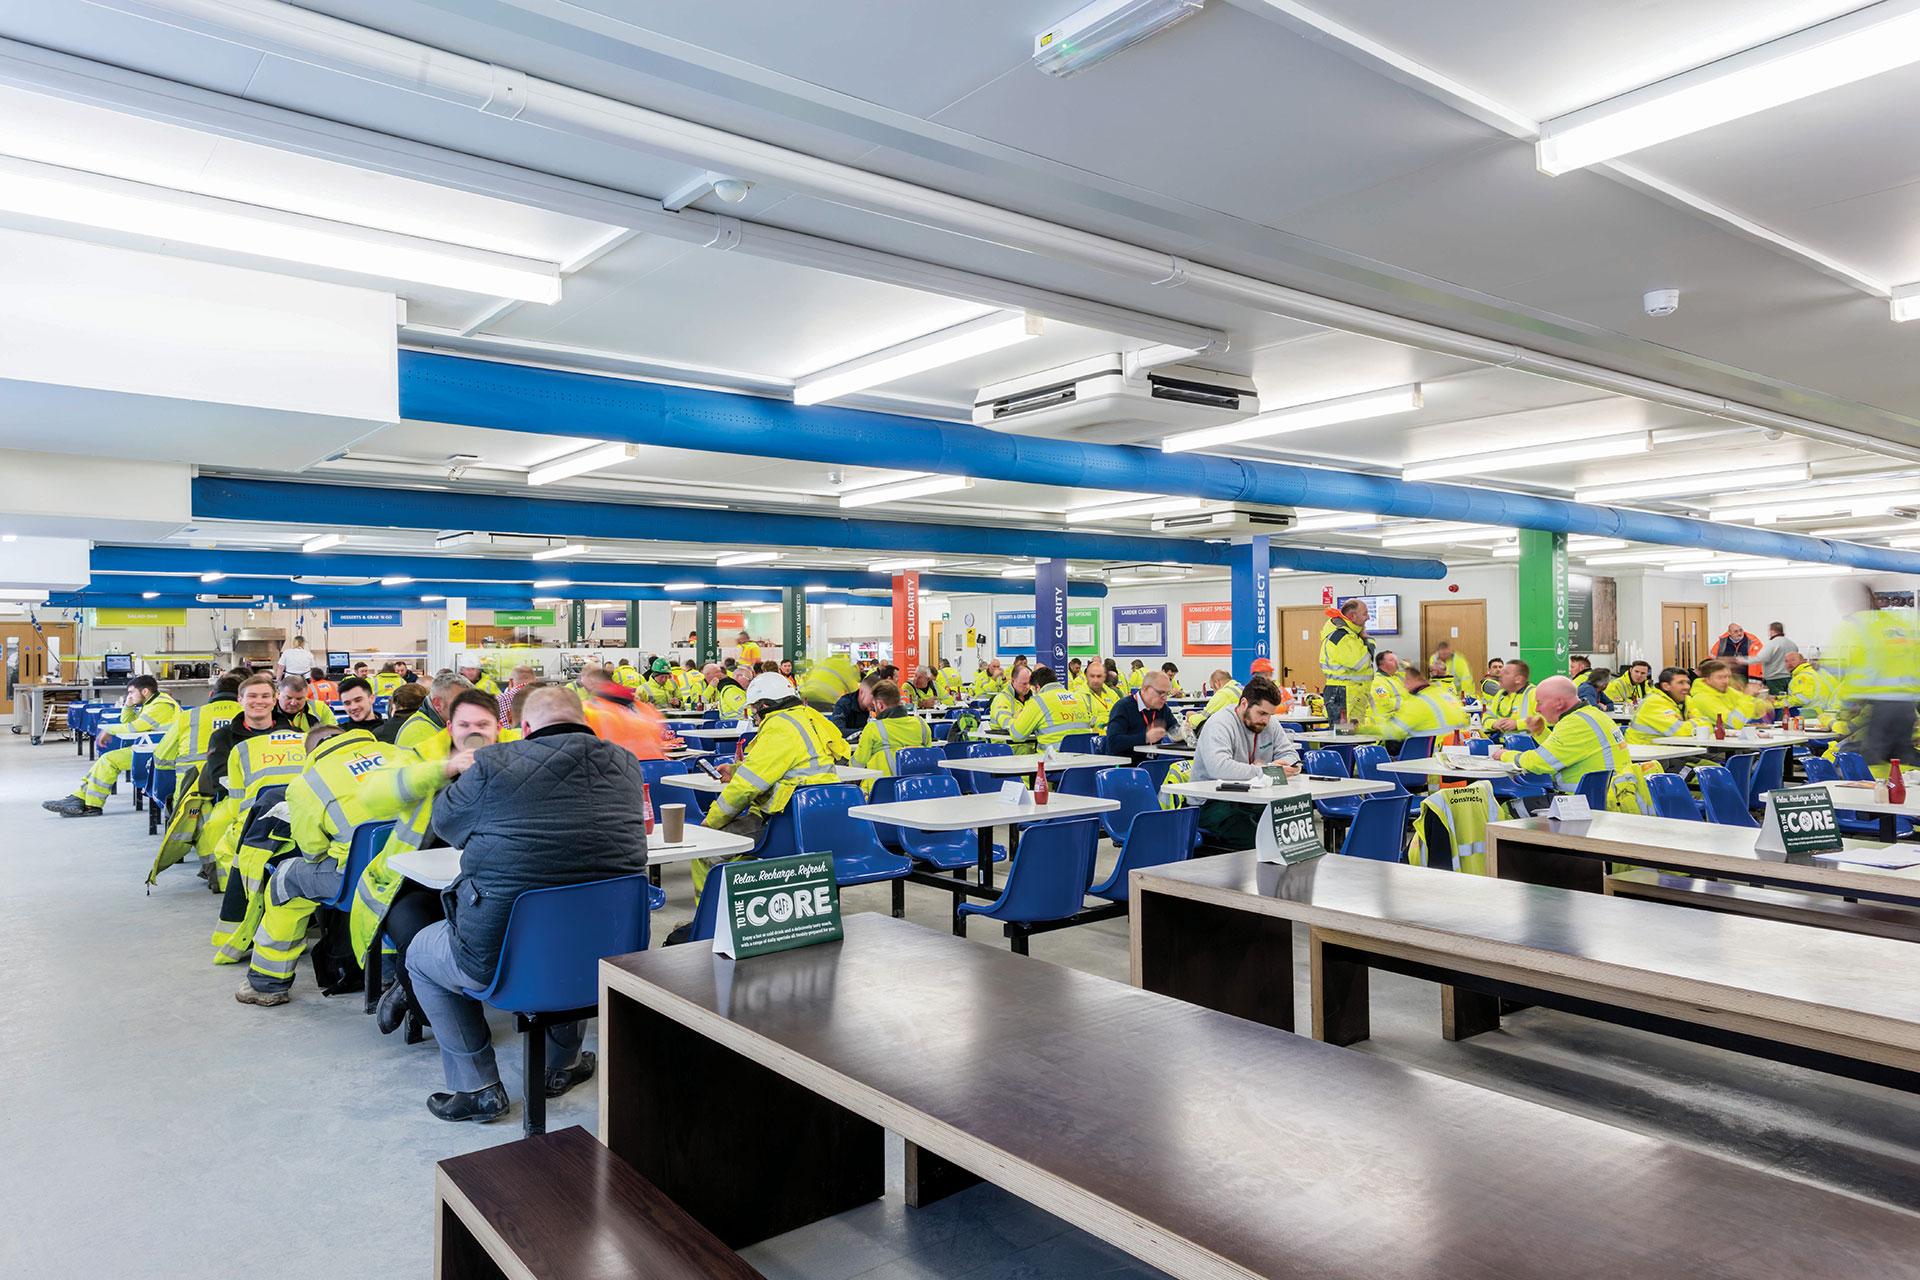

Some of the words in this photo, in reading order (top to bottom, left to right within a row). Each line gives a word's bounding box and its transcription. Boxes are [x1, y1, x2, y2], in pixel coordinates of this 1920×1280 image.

[1055, 587, 1064, 639] CLARITY
[1257, 573, 1266, 634] RESPECT
[213, 720, 232, 730] HP
[271, 733, 302, 741] HPC
[348, 755, 384, 776] HPC
[1453, 787, 1475, 795] Hinkley
[1280, 817, 1315, 844] CORE
[1787, 809, 1836, 833] CORE
[732, 873, 758, 885] Relax.
[758, 867, 797, 883] Recharge.
[797, 861, 829, 879] Refresh.
[734, 899, 746, 917] THE
[746, 886, 832, 927] CORE
[736, 917, 747, 929] TO
